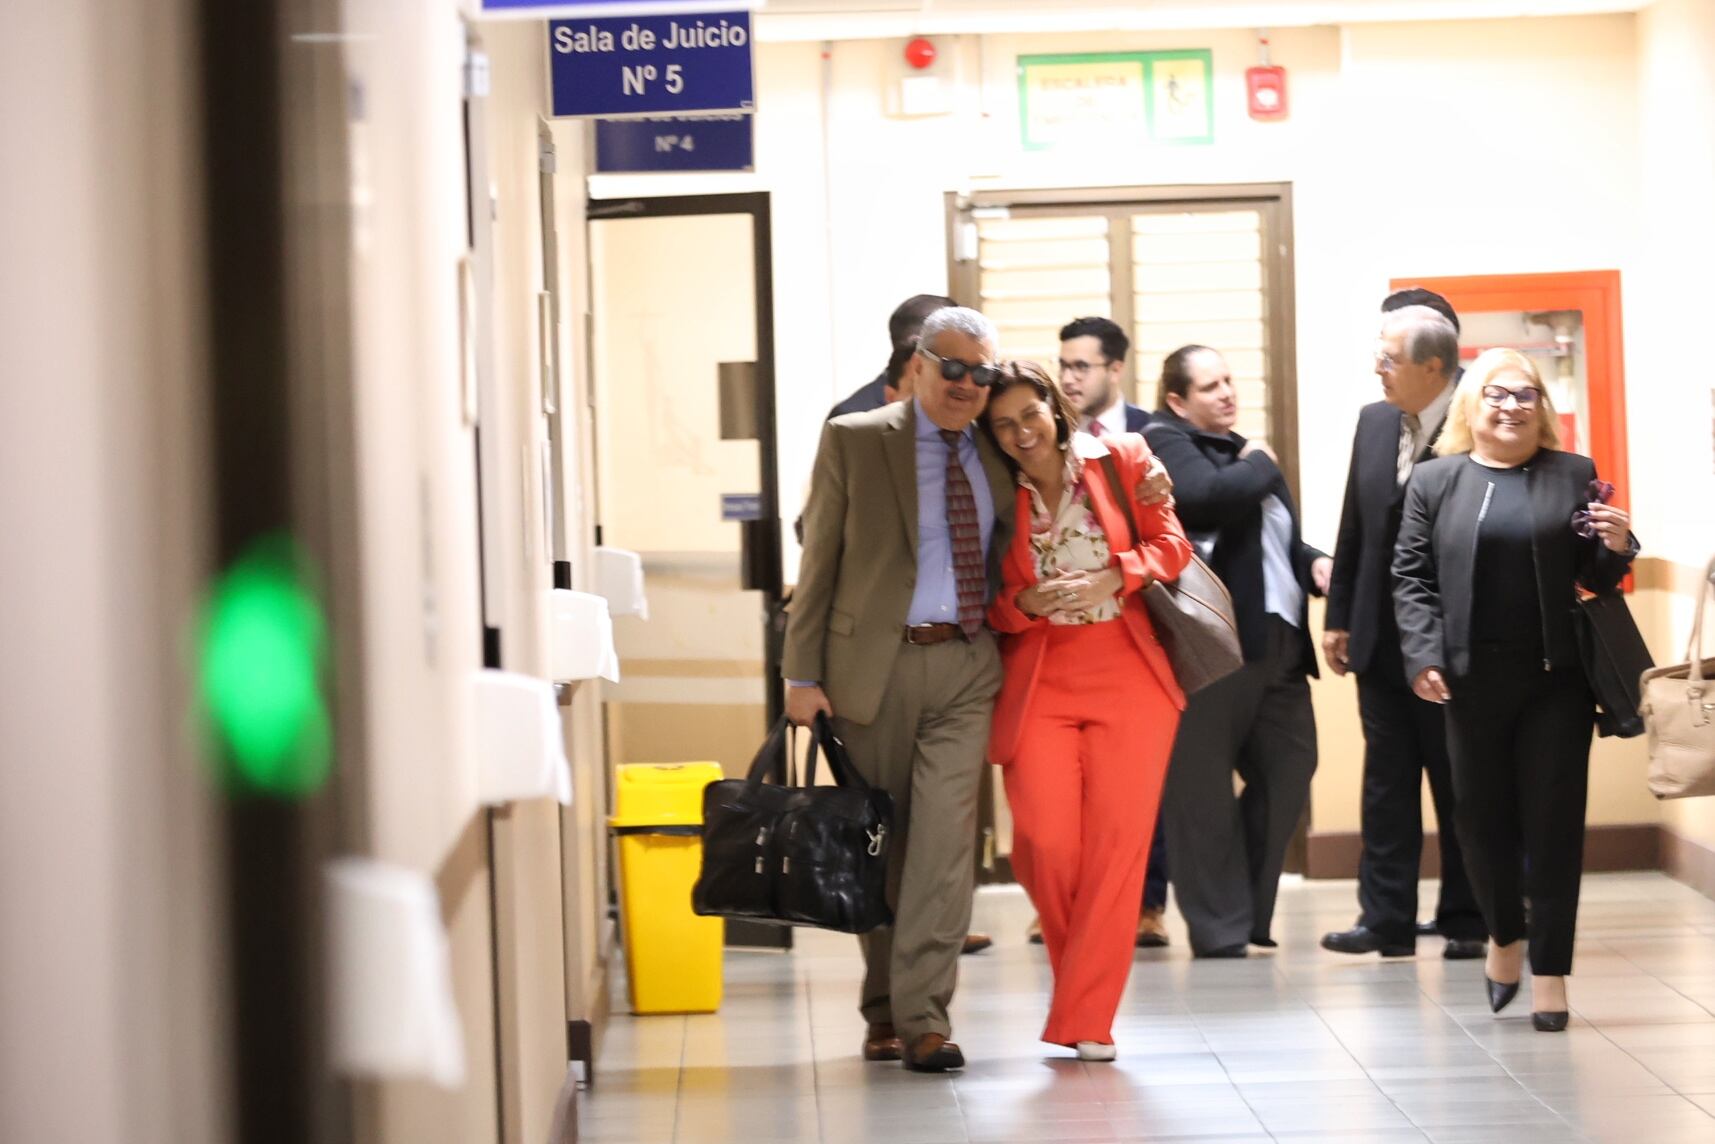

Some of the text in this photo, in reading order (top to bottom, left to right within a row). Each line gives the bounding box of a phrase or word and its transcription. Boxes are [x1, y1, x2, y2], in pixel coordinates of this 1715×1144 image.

[554, 20, 747, 54] Sala de Juicio
[665, 64, 683, 94] 5
[680, 134, 694, 151] 4
